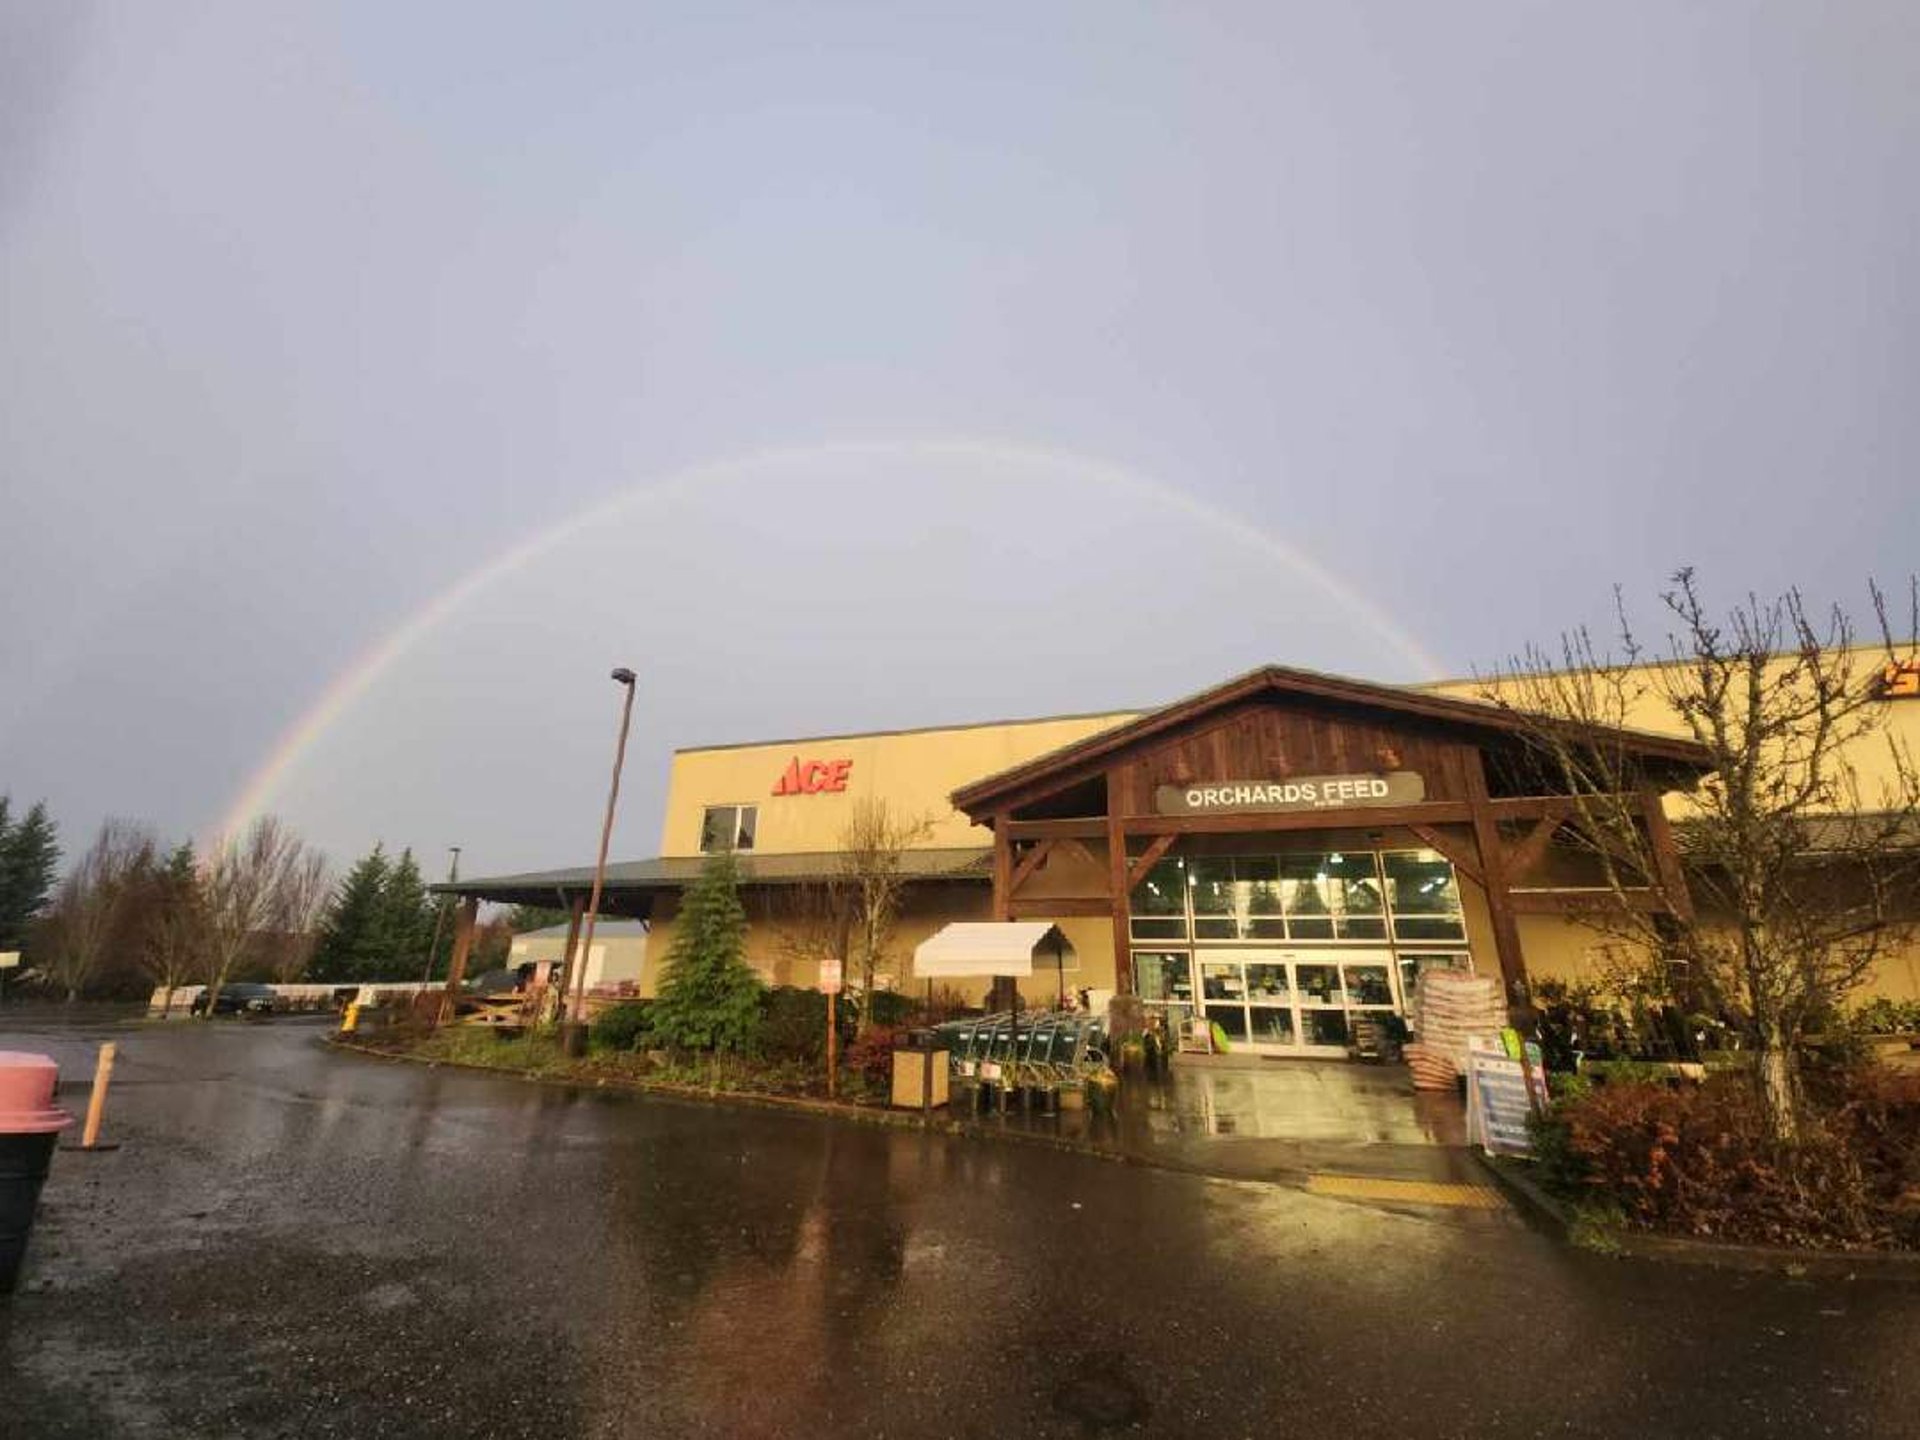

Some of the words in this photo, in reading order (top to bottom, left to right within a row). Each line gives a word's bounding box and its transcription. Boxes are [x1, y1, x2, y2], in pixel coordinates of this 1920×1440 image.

[771, 756, 853, 796] ACE
[1186, 784, 1317, 808] ORCHARDS
[1323, 779, 1389, 800] FEED
